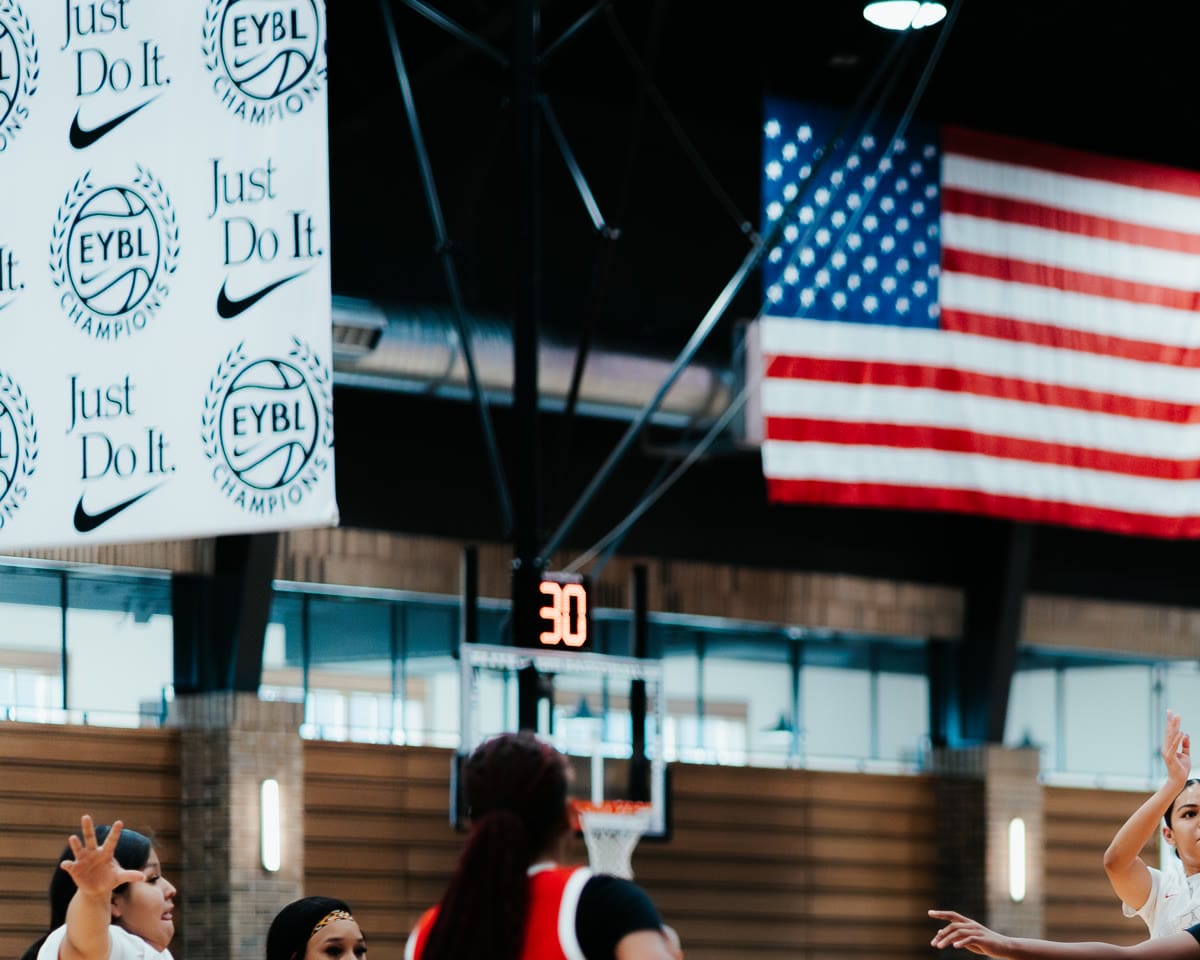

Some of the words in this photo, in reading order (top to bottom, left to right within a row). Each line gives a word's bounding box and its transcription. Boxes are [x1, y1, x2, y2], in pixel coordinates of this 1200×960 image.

[60, 0, 130, 51] Just
[233, 9, 308, 47] EYBL
[75, 47, 132, 97] Do
[139, 39, 171, 88] It.
[207, 157, 277, 220] Just
[80, 227, 150, 268] EYBL
[223, 216, 279, 266] Do
[289, 210, 323, 259] It.
[60, 281, 170, 341] CHAMPIONS
[65, 373, 136, 436] Just
[233, 400, 306, 436] EYBL
[80, 432, 137, 481] Do
[145, 426, 176, 474] It.
[213, 456, 327, 515] CHAMPIONS
[539, 581, 587, 647] 30
